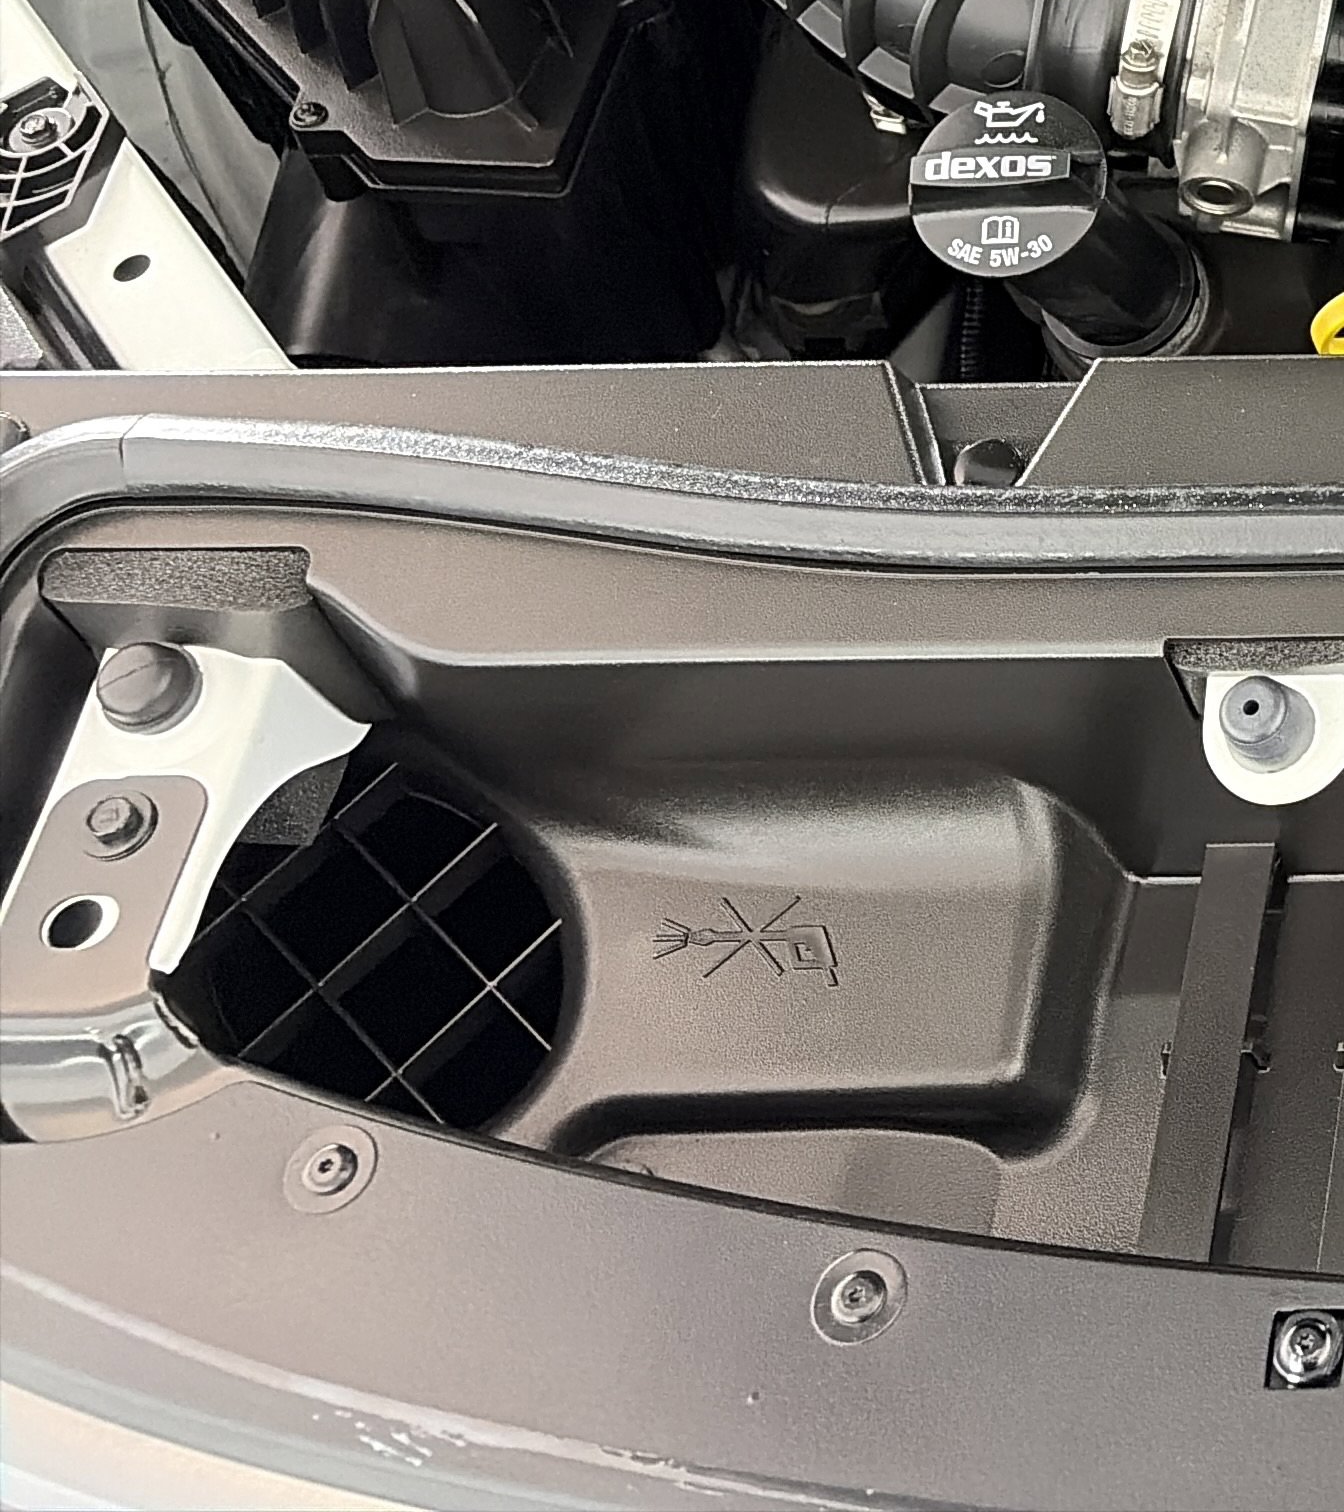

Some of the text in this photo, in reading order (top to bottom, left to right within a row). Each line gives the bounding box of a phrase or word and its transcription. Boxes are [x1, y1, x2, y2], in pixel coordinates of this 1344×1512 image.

[924, 151, 1053, 180] dexos
[947, 234, 1053, 268] SAE 5W-30
